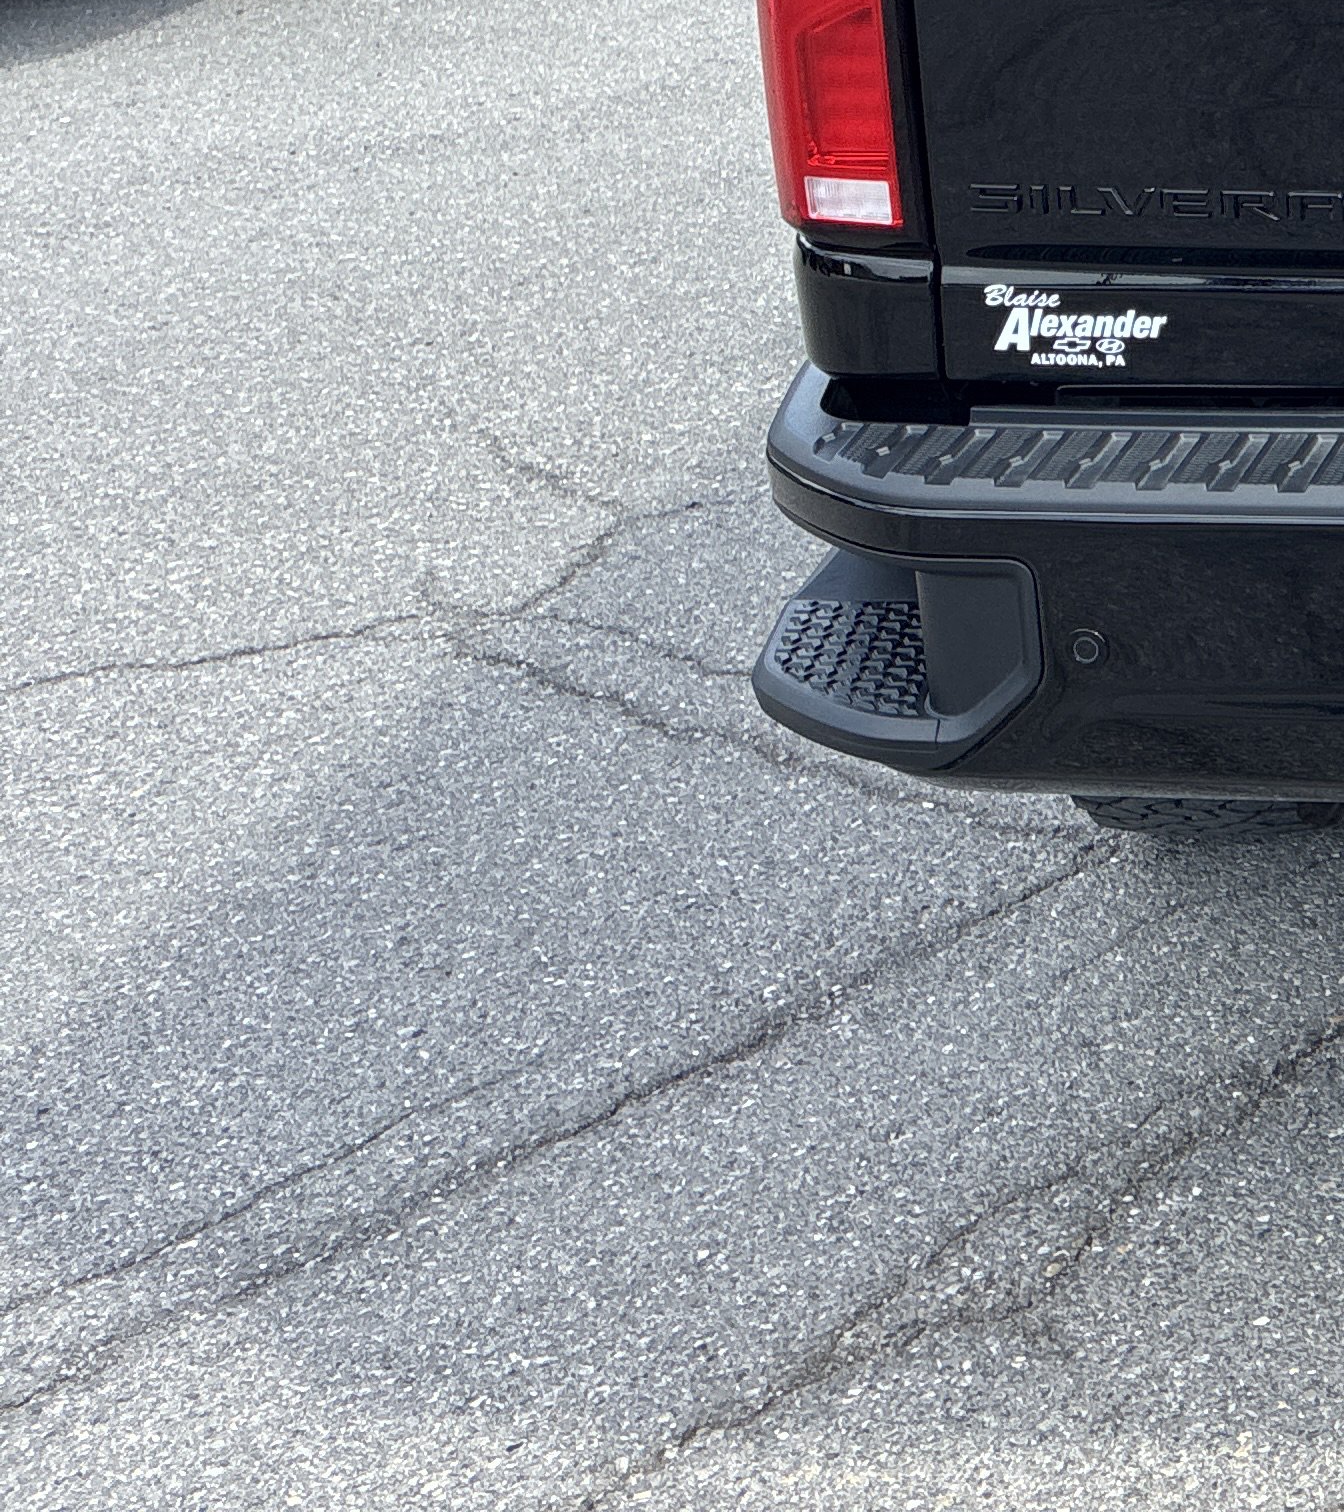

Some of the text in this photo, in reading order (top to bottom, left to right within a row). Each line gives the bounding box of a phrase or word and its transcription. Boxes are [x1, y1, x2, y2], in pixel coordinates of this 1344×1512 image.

[983, 284, 1061, 307] Blaise
[994, 307, 1167, 351] Alexander
[1030, 353, 1125, 368] ALTOONA, PA
